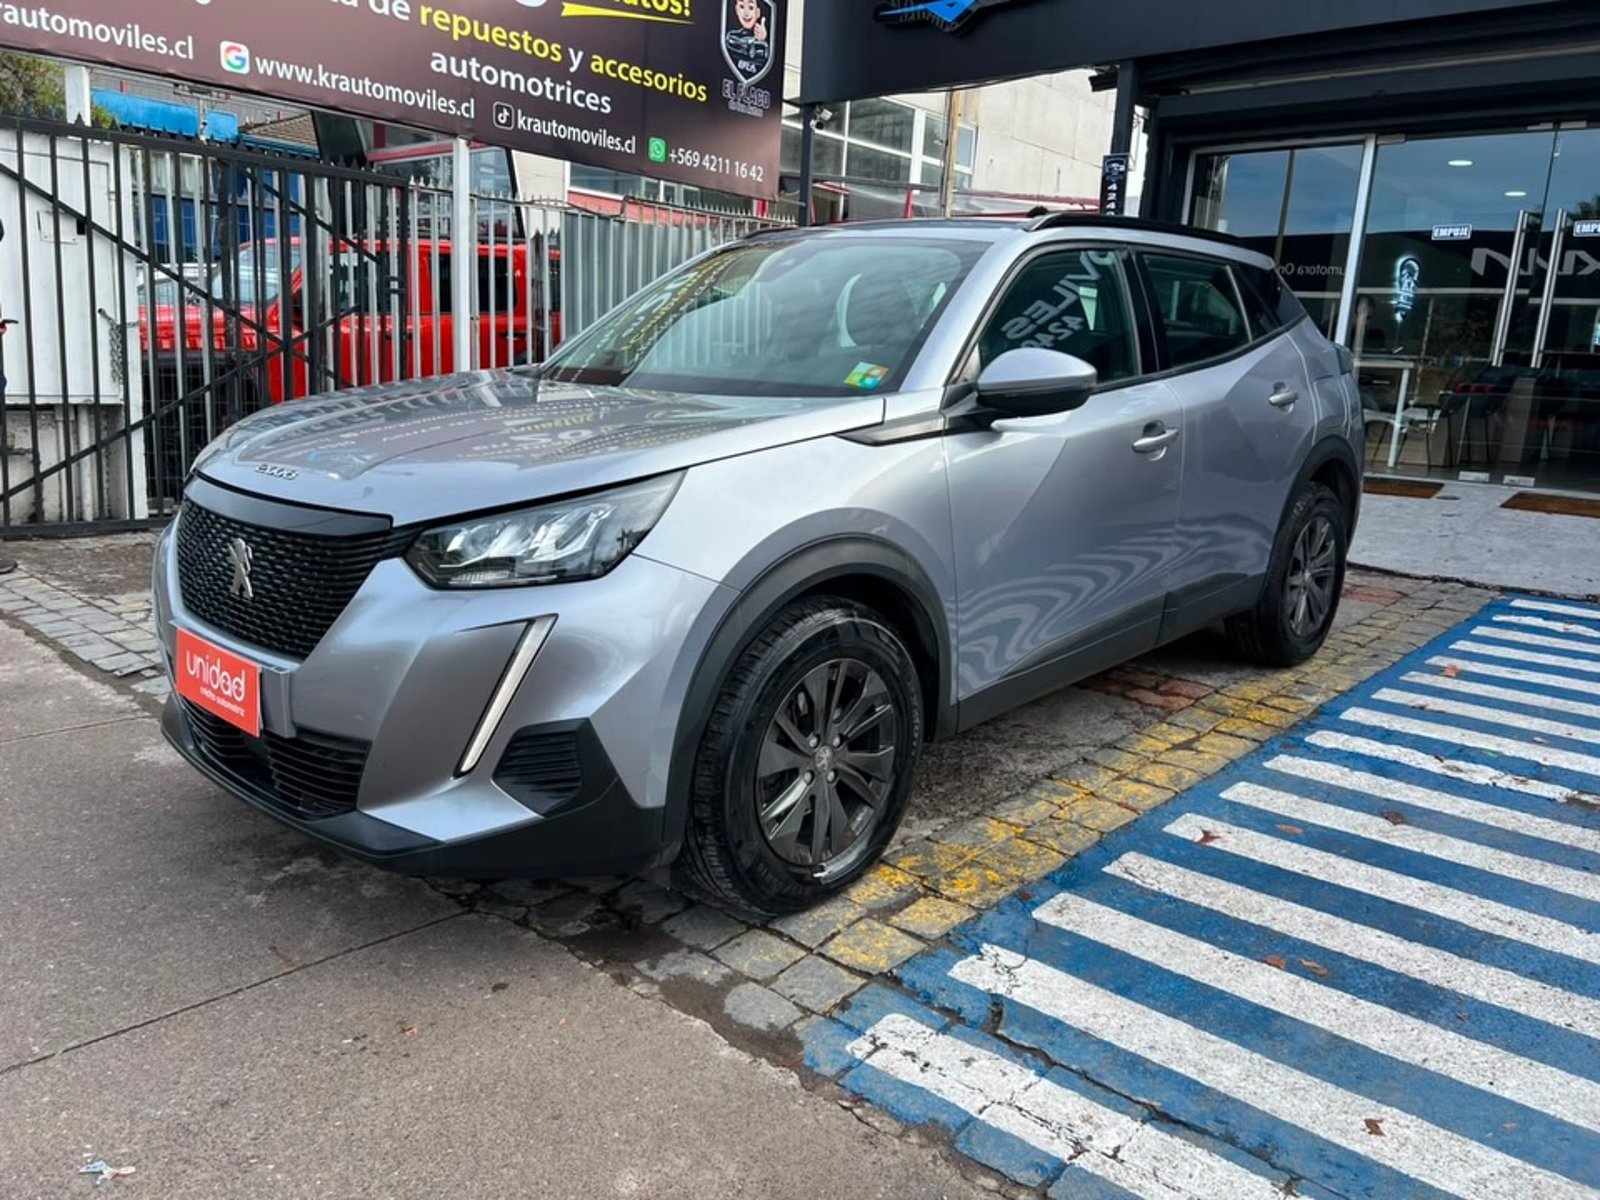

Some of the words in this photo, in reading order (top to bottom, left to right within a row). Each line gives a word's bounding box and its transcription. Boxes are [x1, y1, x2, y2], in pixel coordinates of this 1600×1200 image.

[0, 2, 194, 60] automoviles.cl
[419, 5, 562, 62] repuestos
[568, 47, 584, 73] y
[591, 54, 708, 102] accesorios
[255, 56, 475, 119] www.krautomoviles.cl
[430, 52, 612, 114] automotrices
[517, 109, 636, 155] krautomoviles.cl
[669, 148, 700, 168] +569
[702, 154, 731, 175] 4211
[735, 161, 748, 178] 16
[750, 165, 764, 182] 42
[186, 649, 246, 702] unidad
